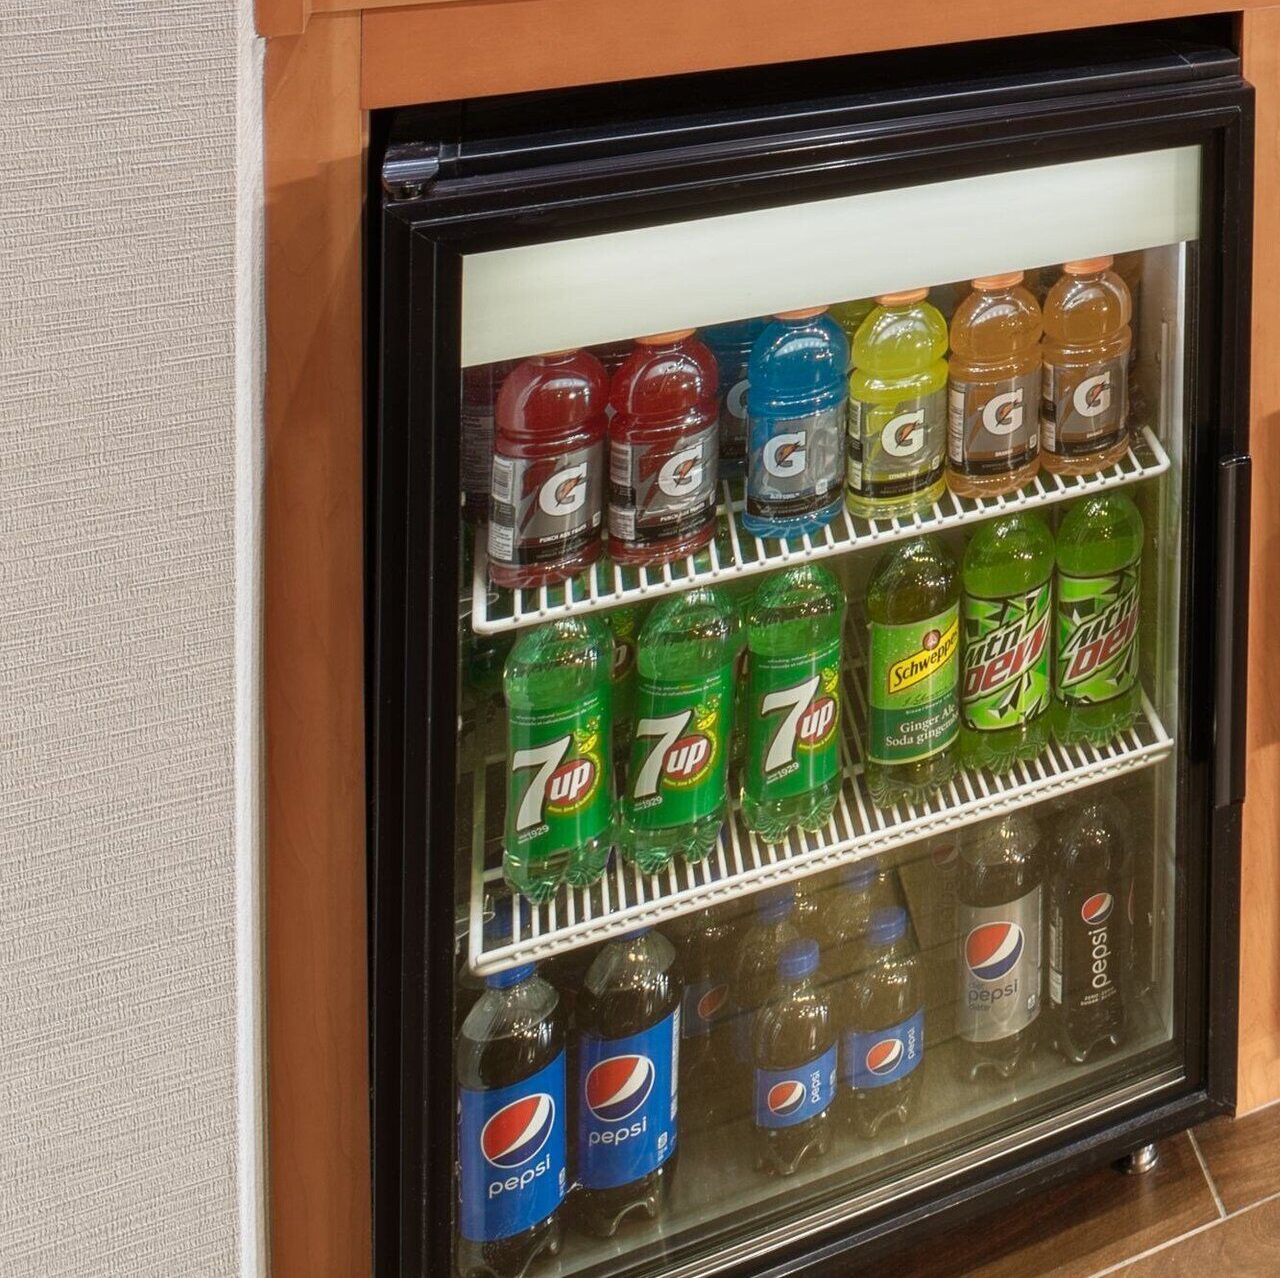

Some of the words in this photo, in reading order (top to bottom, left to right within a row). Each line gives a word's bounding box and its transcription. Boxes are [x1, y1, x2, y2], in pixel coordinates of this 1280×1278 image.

[982, 388, 1023, 436] G
[1073, 372, 1112, 418] G
[882, 408, 924, 457] G
[658, 444, 703, 497] G
[763, 432, 806, 478] G
[539, 462, 588, 517] G
[894, 632, 958, 686] Schweppe
[886, 734, 914, 747] Soda
[900, 714, 940, 734] Ginger
[776, 762, 799, 778] 1929
[642, 796, 663, 810] 1929
[526, 826, 550, 838] 1929
[1091, 926, 1108, 989] pepsi
[968, 980, 1018, 1004] pepsi
[907, 1026, 916, 1060] pepsi
[810, 1068, 820, 1104] pepsi
[588, 1116, 646, 1147] pepsi
[488, 1154, 550, 1199] pepsi
